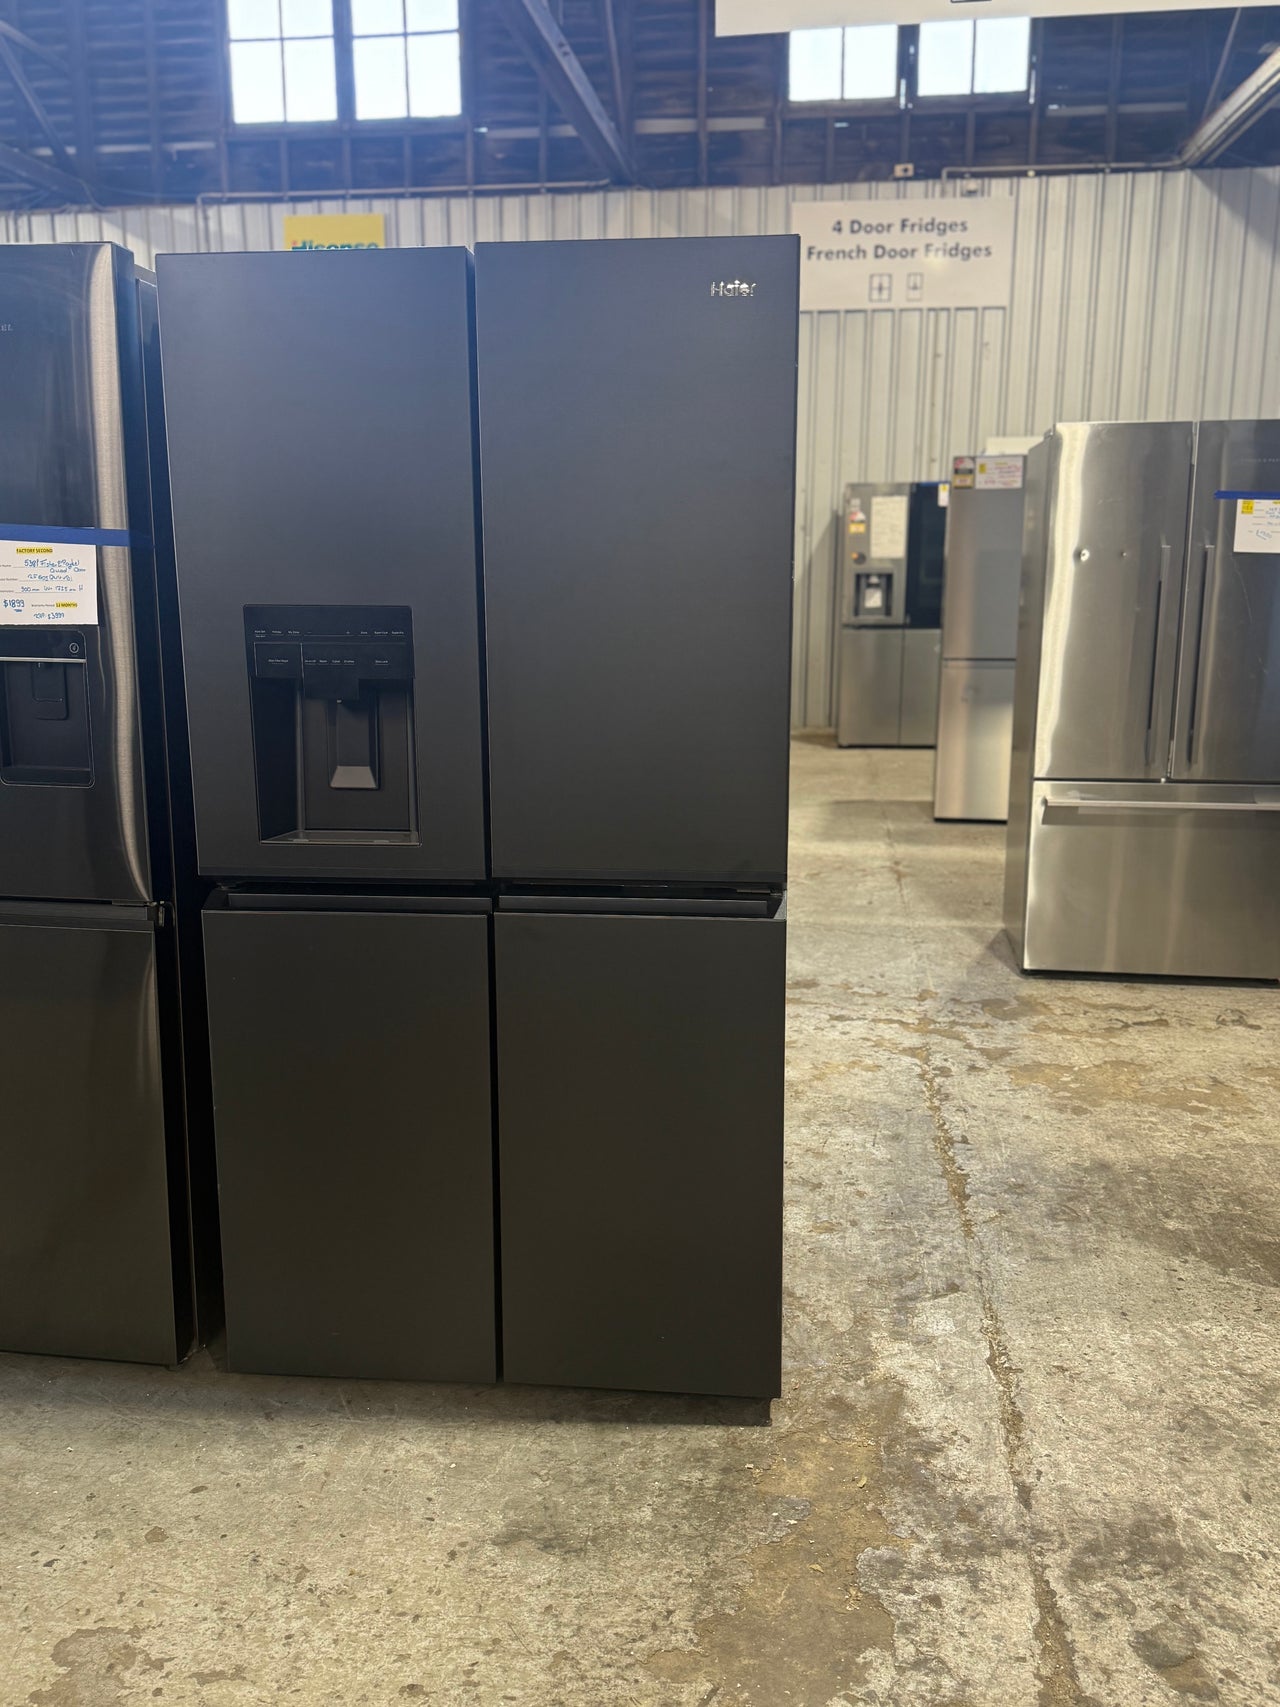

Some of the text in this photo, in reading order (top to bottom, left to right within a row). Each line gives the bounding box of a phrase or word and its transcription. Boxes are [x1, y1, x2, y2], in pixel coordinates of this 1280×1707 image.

[832, 217, 968, 237] 4 Door Fridges
[806, 242, 992, 262] French Door Fridges
[710, 280, 757, 297] Haier
